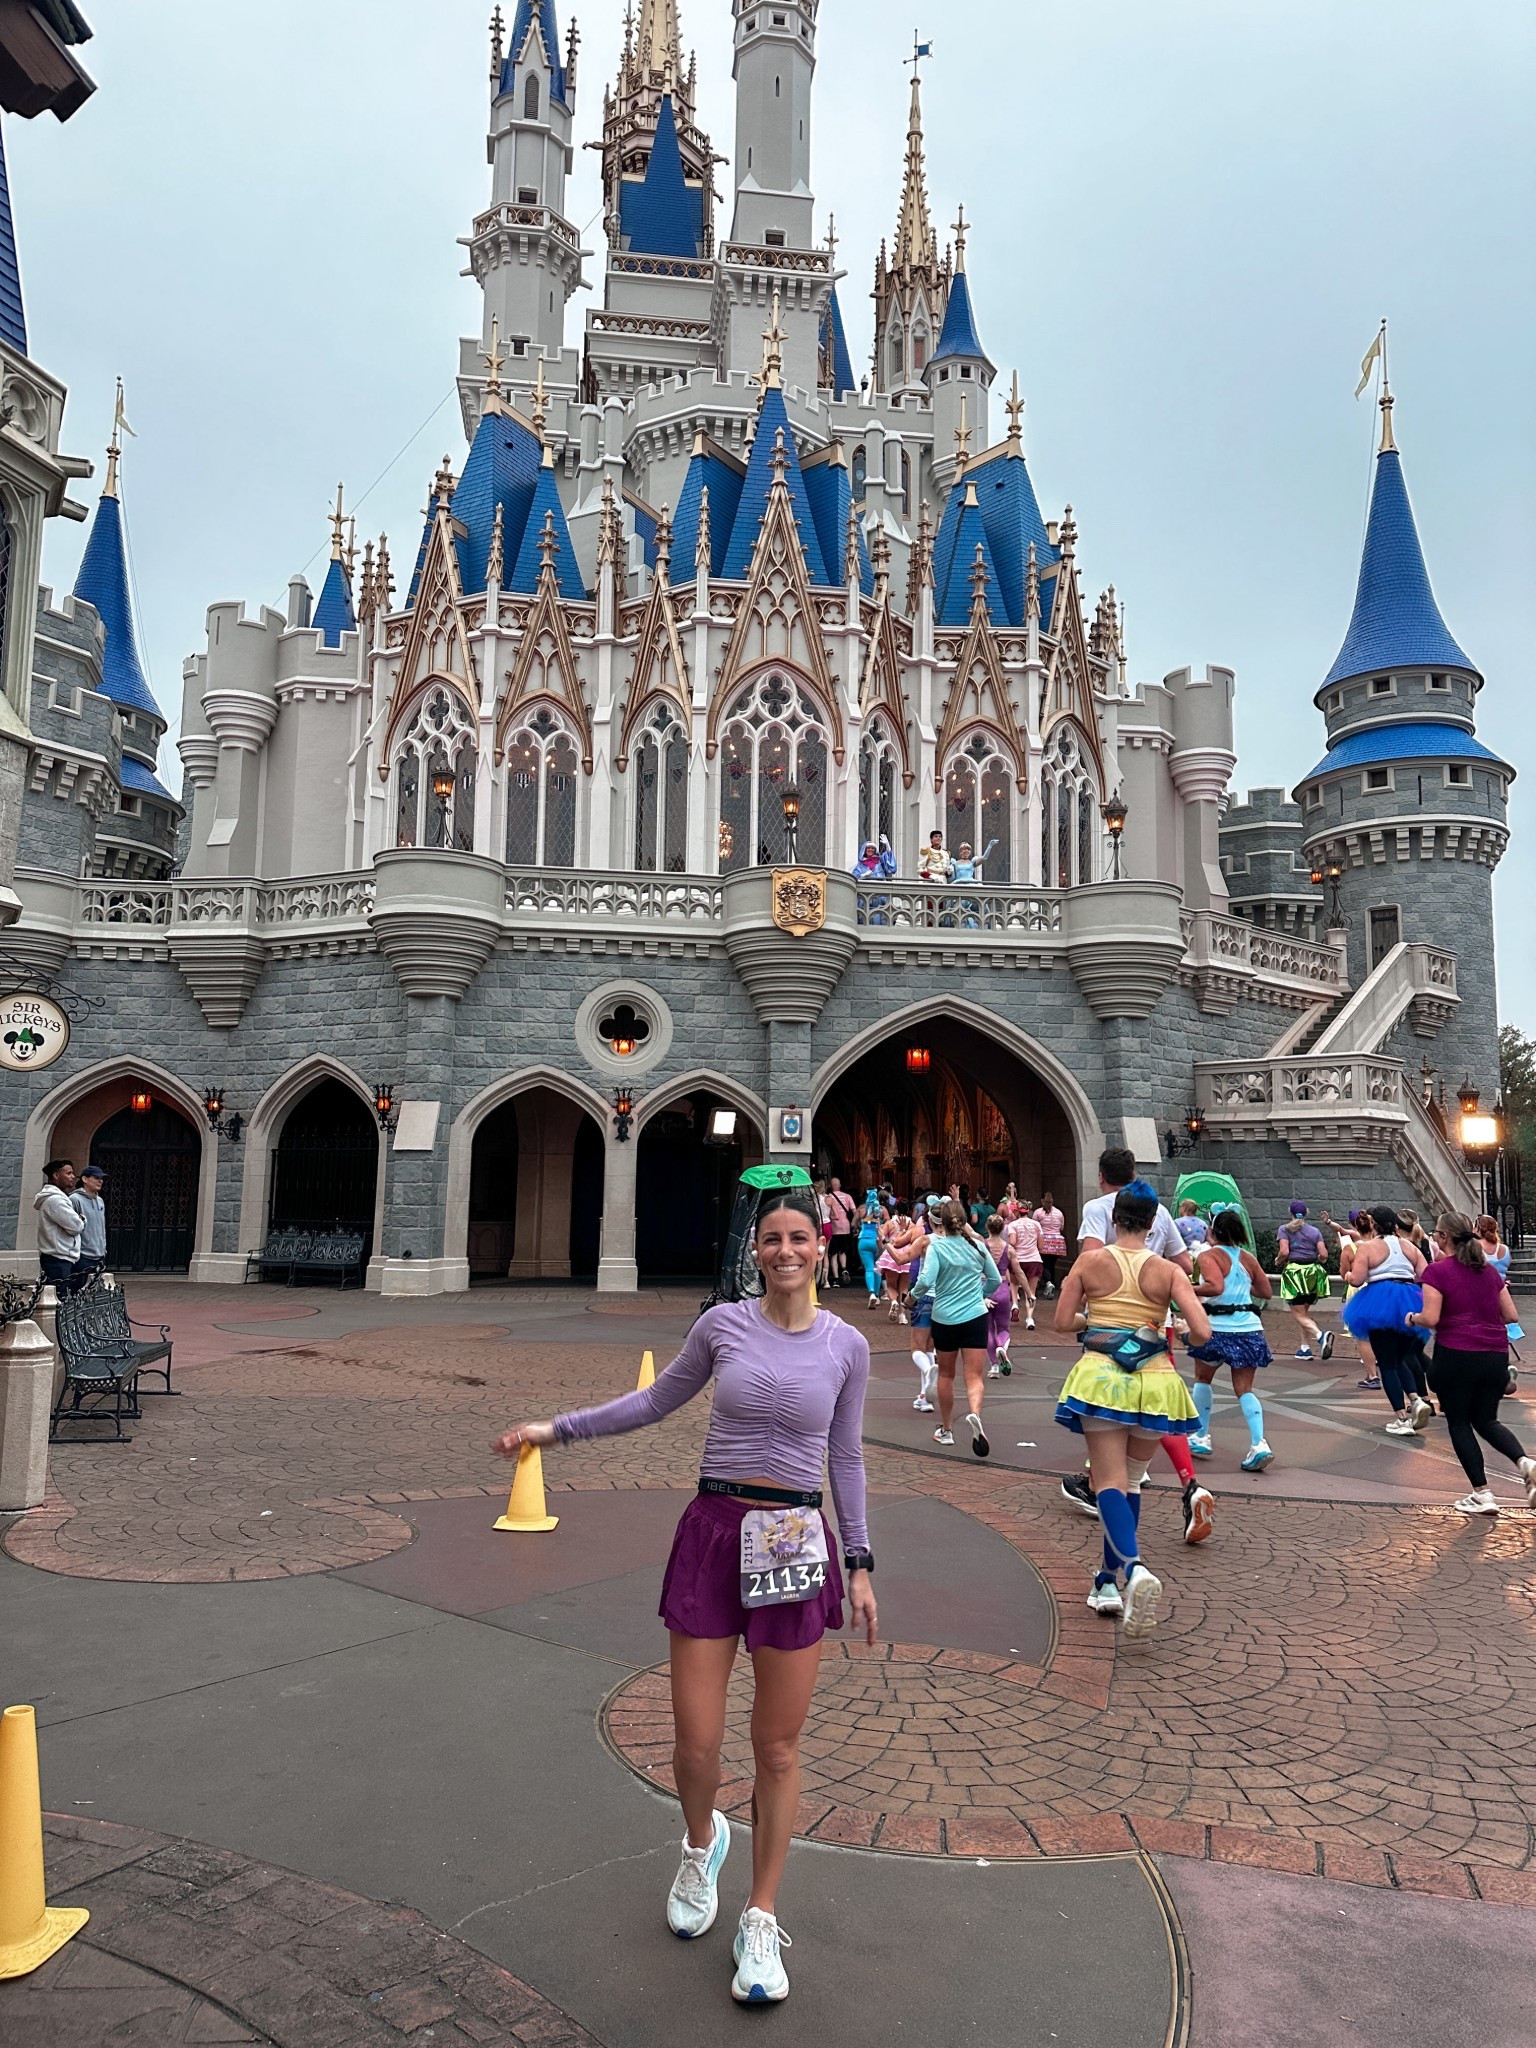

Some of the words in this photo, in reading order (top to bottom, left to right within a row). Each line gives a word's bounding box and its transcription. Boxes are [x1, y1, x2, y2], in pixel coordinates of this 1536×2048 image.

[12, 1001, 41, 1014] SIR
[744, 1531, 753, 1564] 21134
[748, 1563, 826, 1597] 21134
